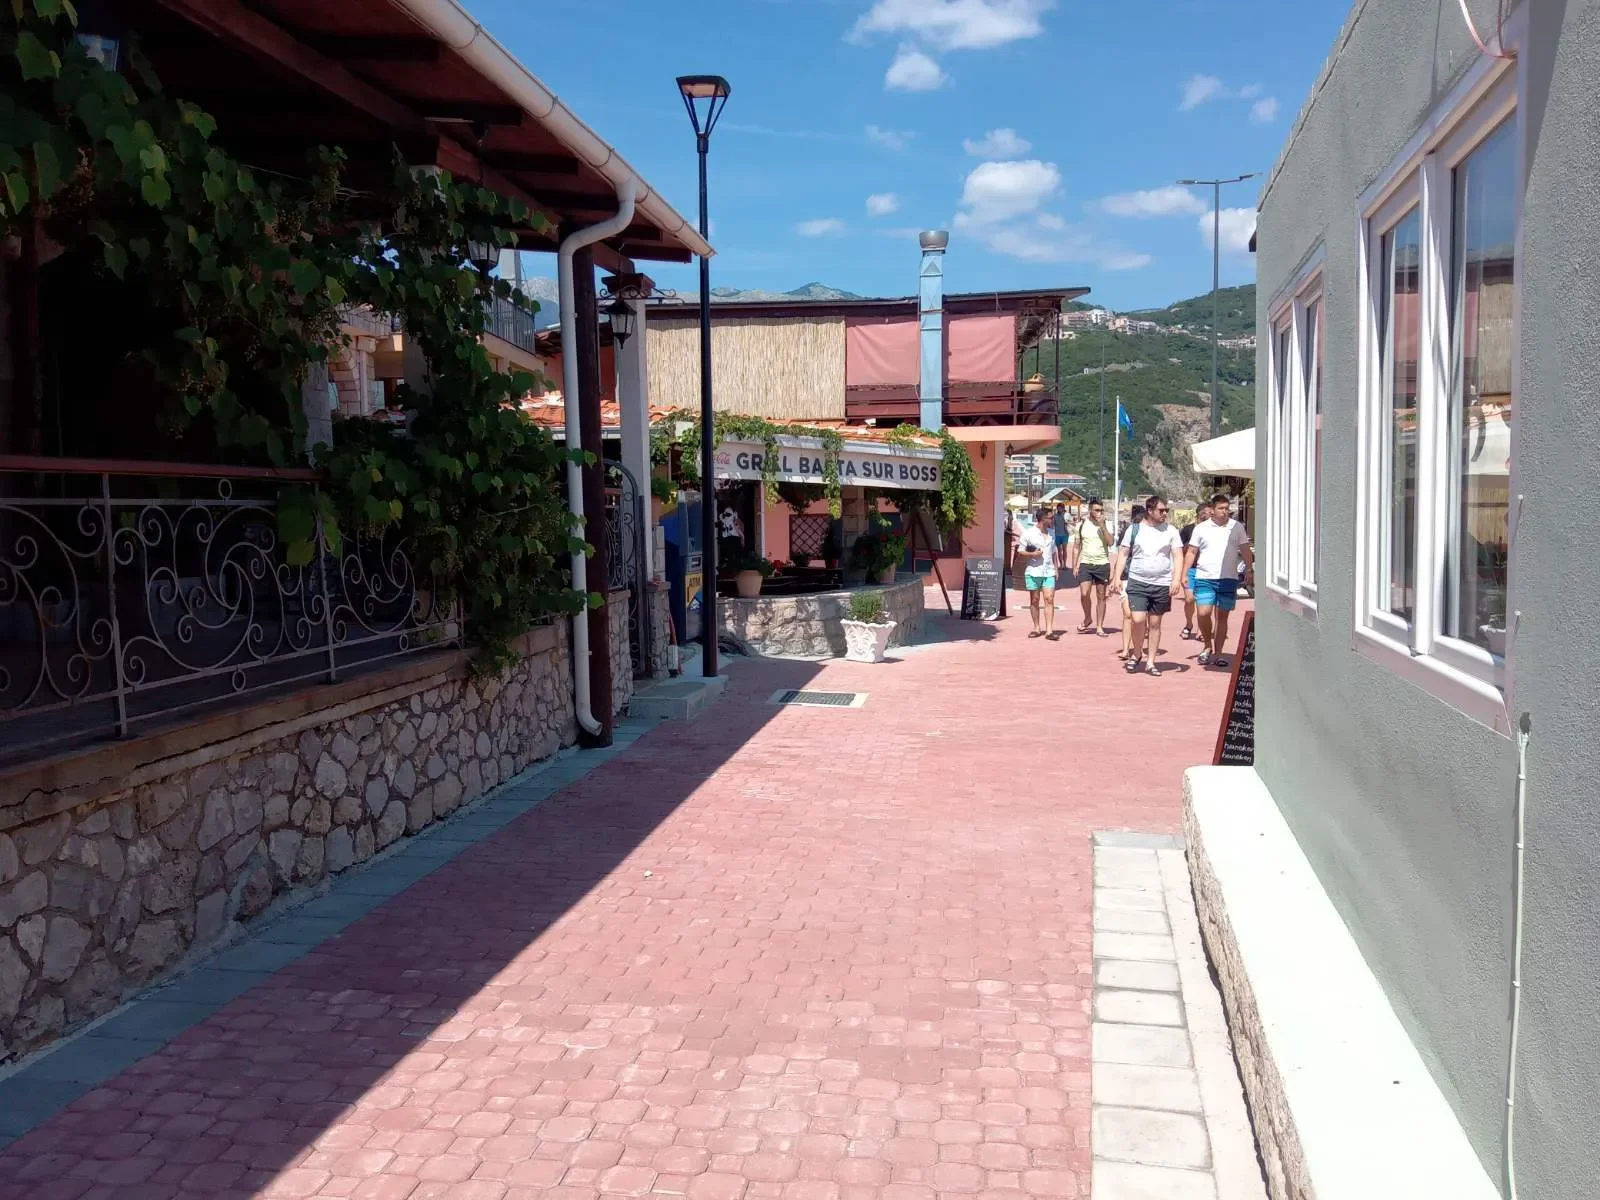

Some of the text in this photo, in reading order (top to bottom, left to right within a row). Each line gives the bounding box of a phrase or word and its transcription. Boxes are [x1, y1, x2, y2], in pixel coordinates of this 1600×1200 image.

[736, 452, 937, 482] GRL BATA SUR BOSS
